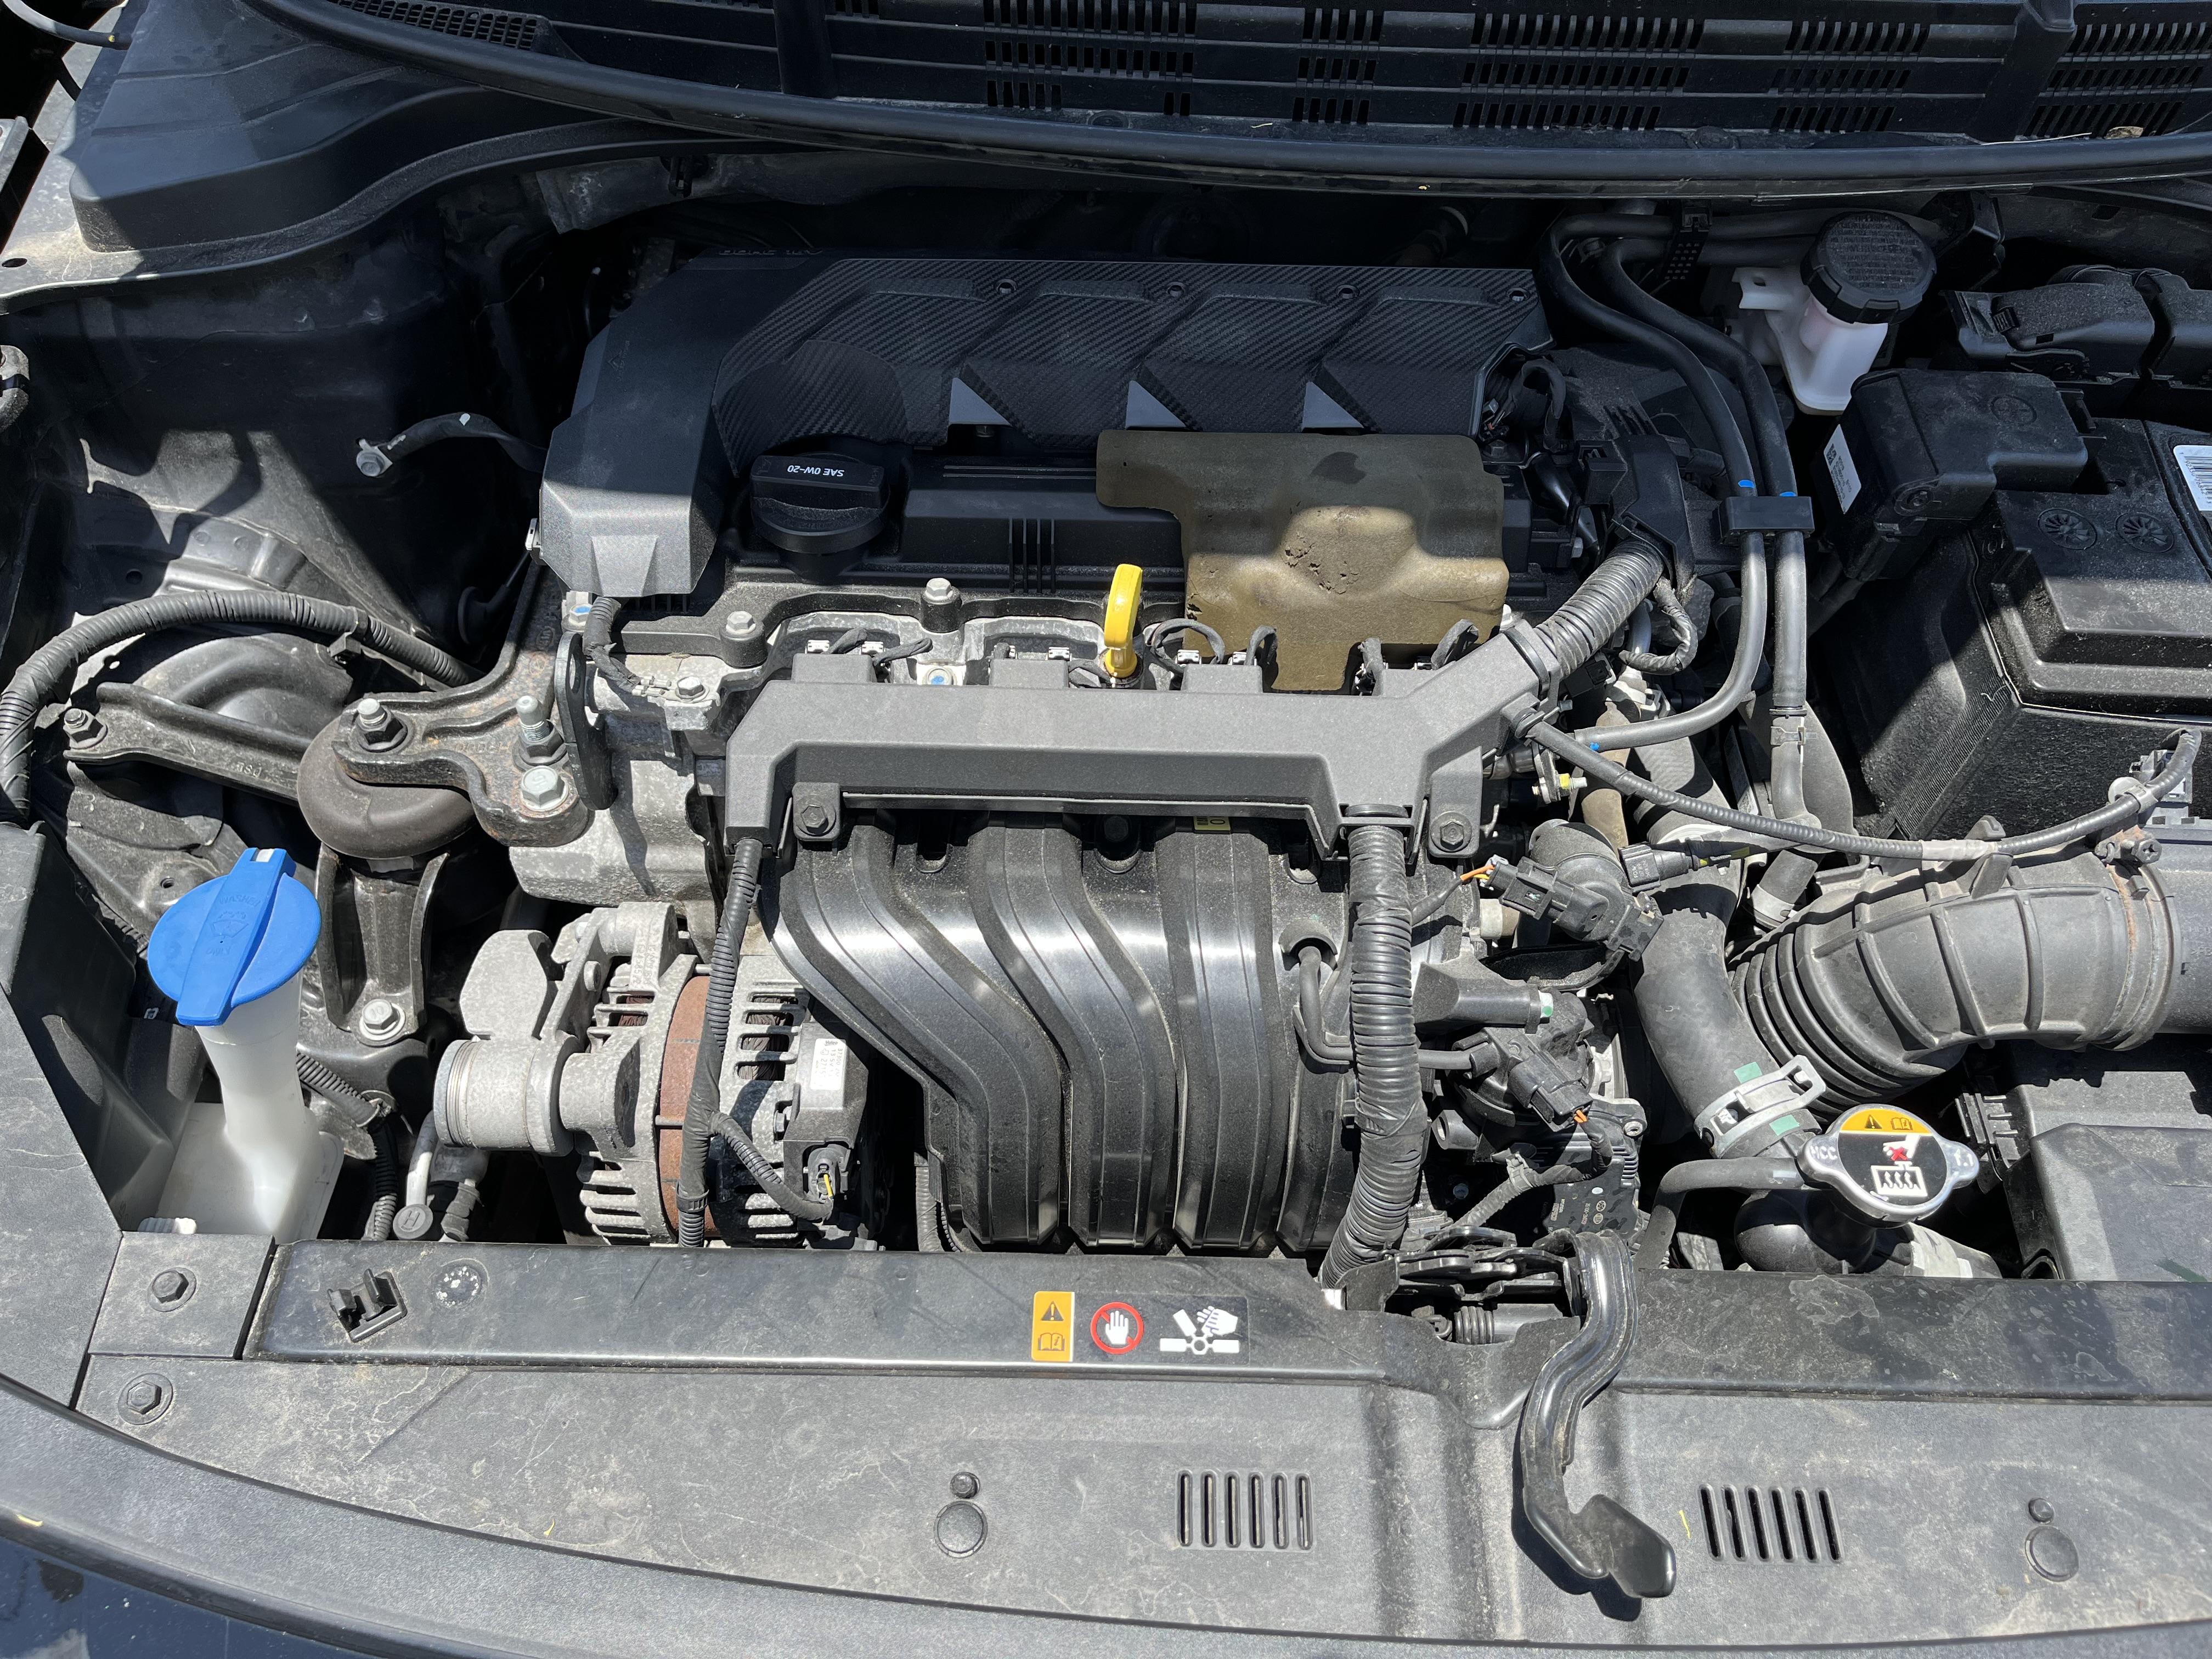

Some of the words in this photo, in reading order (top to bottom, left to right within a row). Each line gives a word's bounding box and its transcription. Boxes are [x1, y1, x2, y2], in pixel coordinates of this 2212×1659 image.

[787, 465, 821, 475] 0W-20
[822, 467, 845, 477] SAE
[1810, 1145, 1838, 1160] HCC
[1953, 1148, 1974, 1167] 1.1
